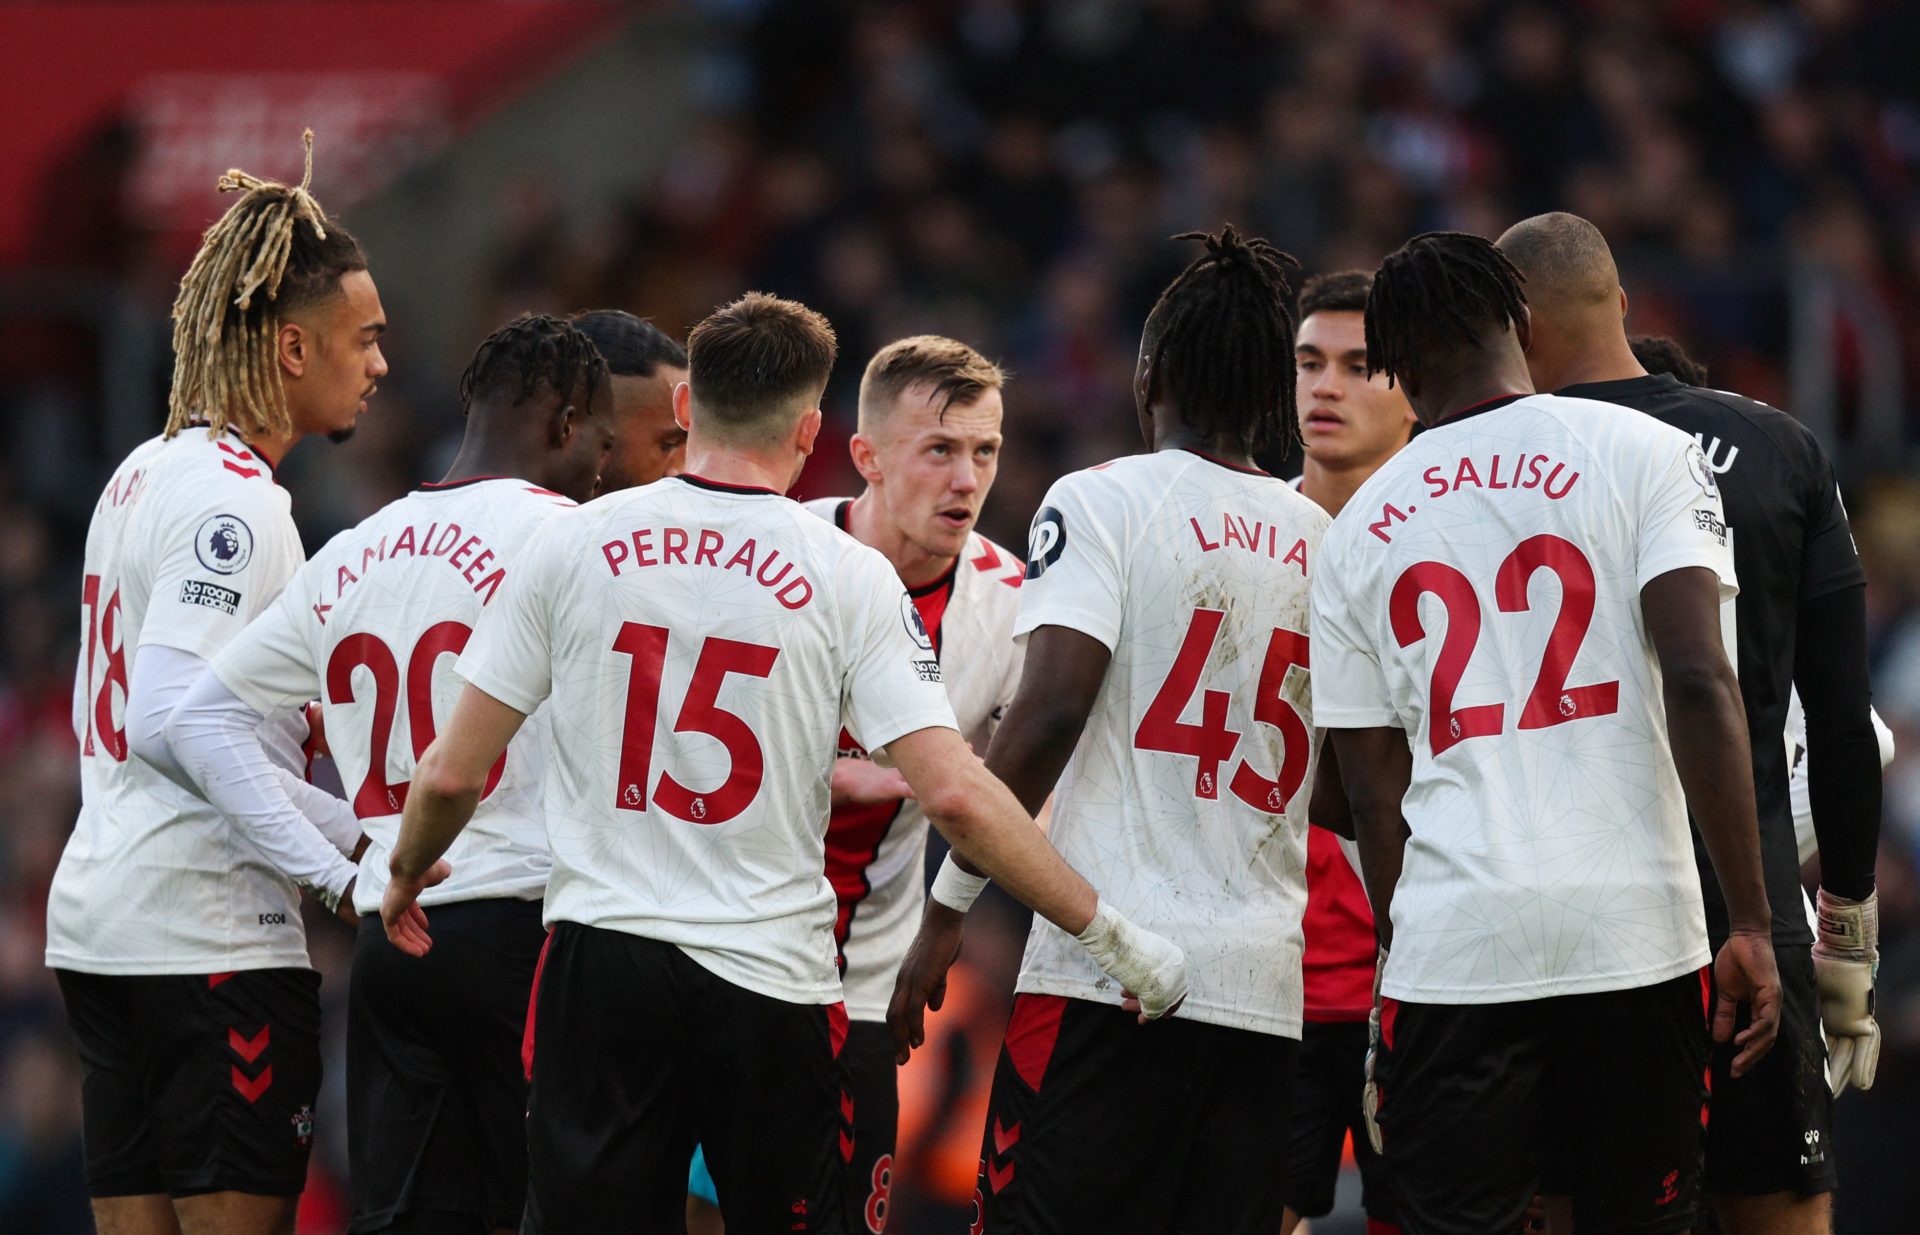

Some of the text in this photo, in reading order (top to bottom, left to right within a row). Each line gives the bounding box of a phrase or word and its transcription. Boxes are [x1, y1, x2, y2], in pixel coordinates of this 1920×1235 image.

[1368, 453, 1580, 544] M. SALISU
[601, 527, 814, 610] PERRAUD
[1189, 512, 1308, 577] LAVIA
[180, 592, 237, 616] for racism
[182, 580, 235, 604] No room
[83, 574, 129, 763] 18
[911, 661, 928, 672] No
[1388, 533, 1621, 760] 22
[326, 620, 508, 821] 20
[611, 620, 782, 826] 15
[1134, 606, 1311, 816] 45
[865, 1153, 894, 1235] 8
